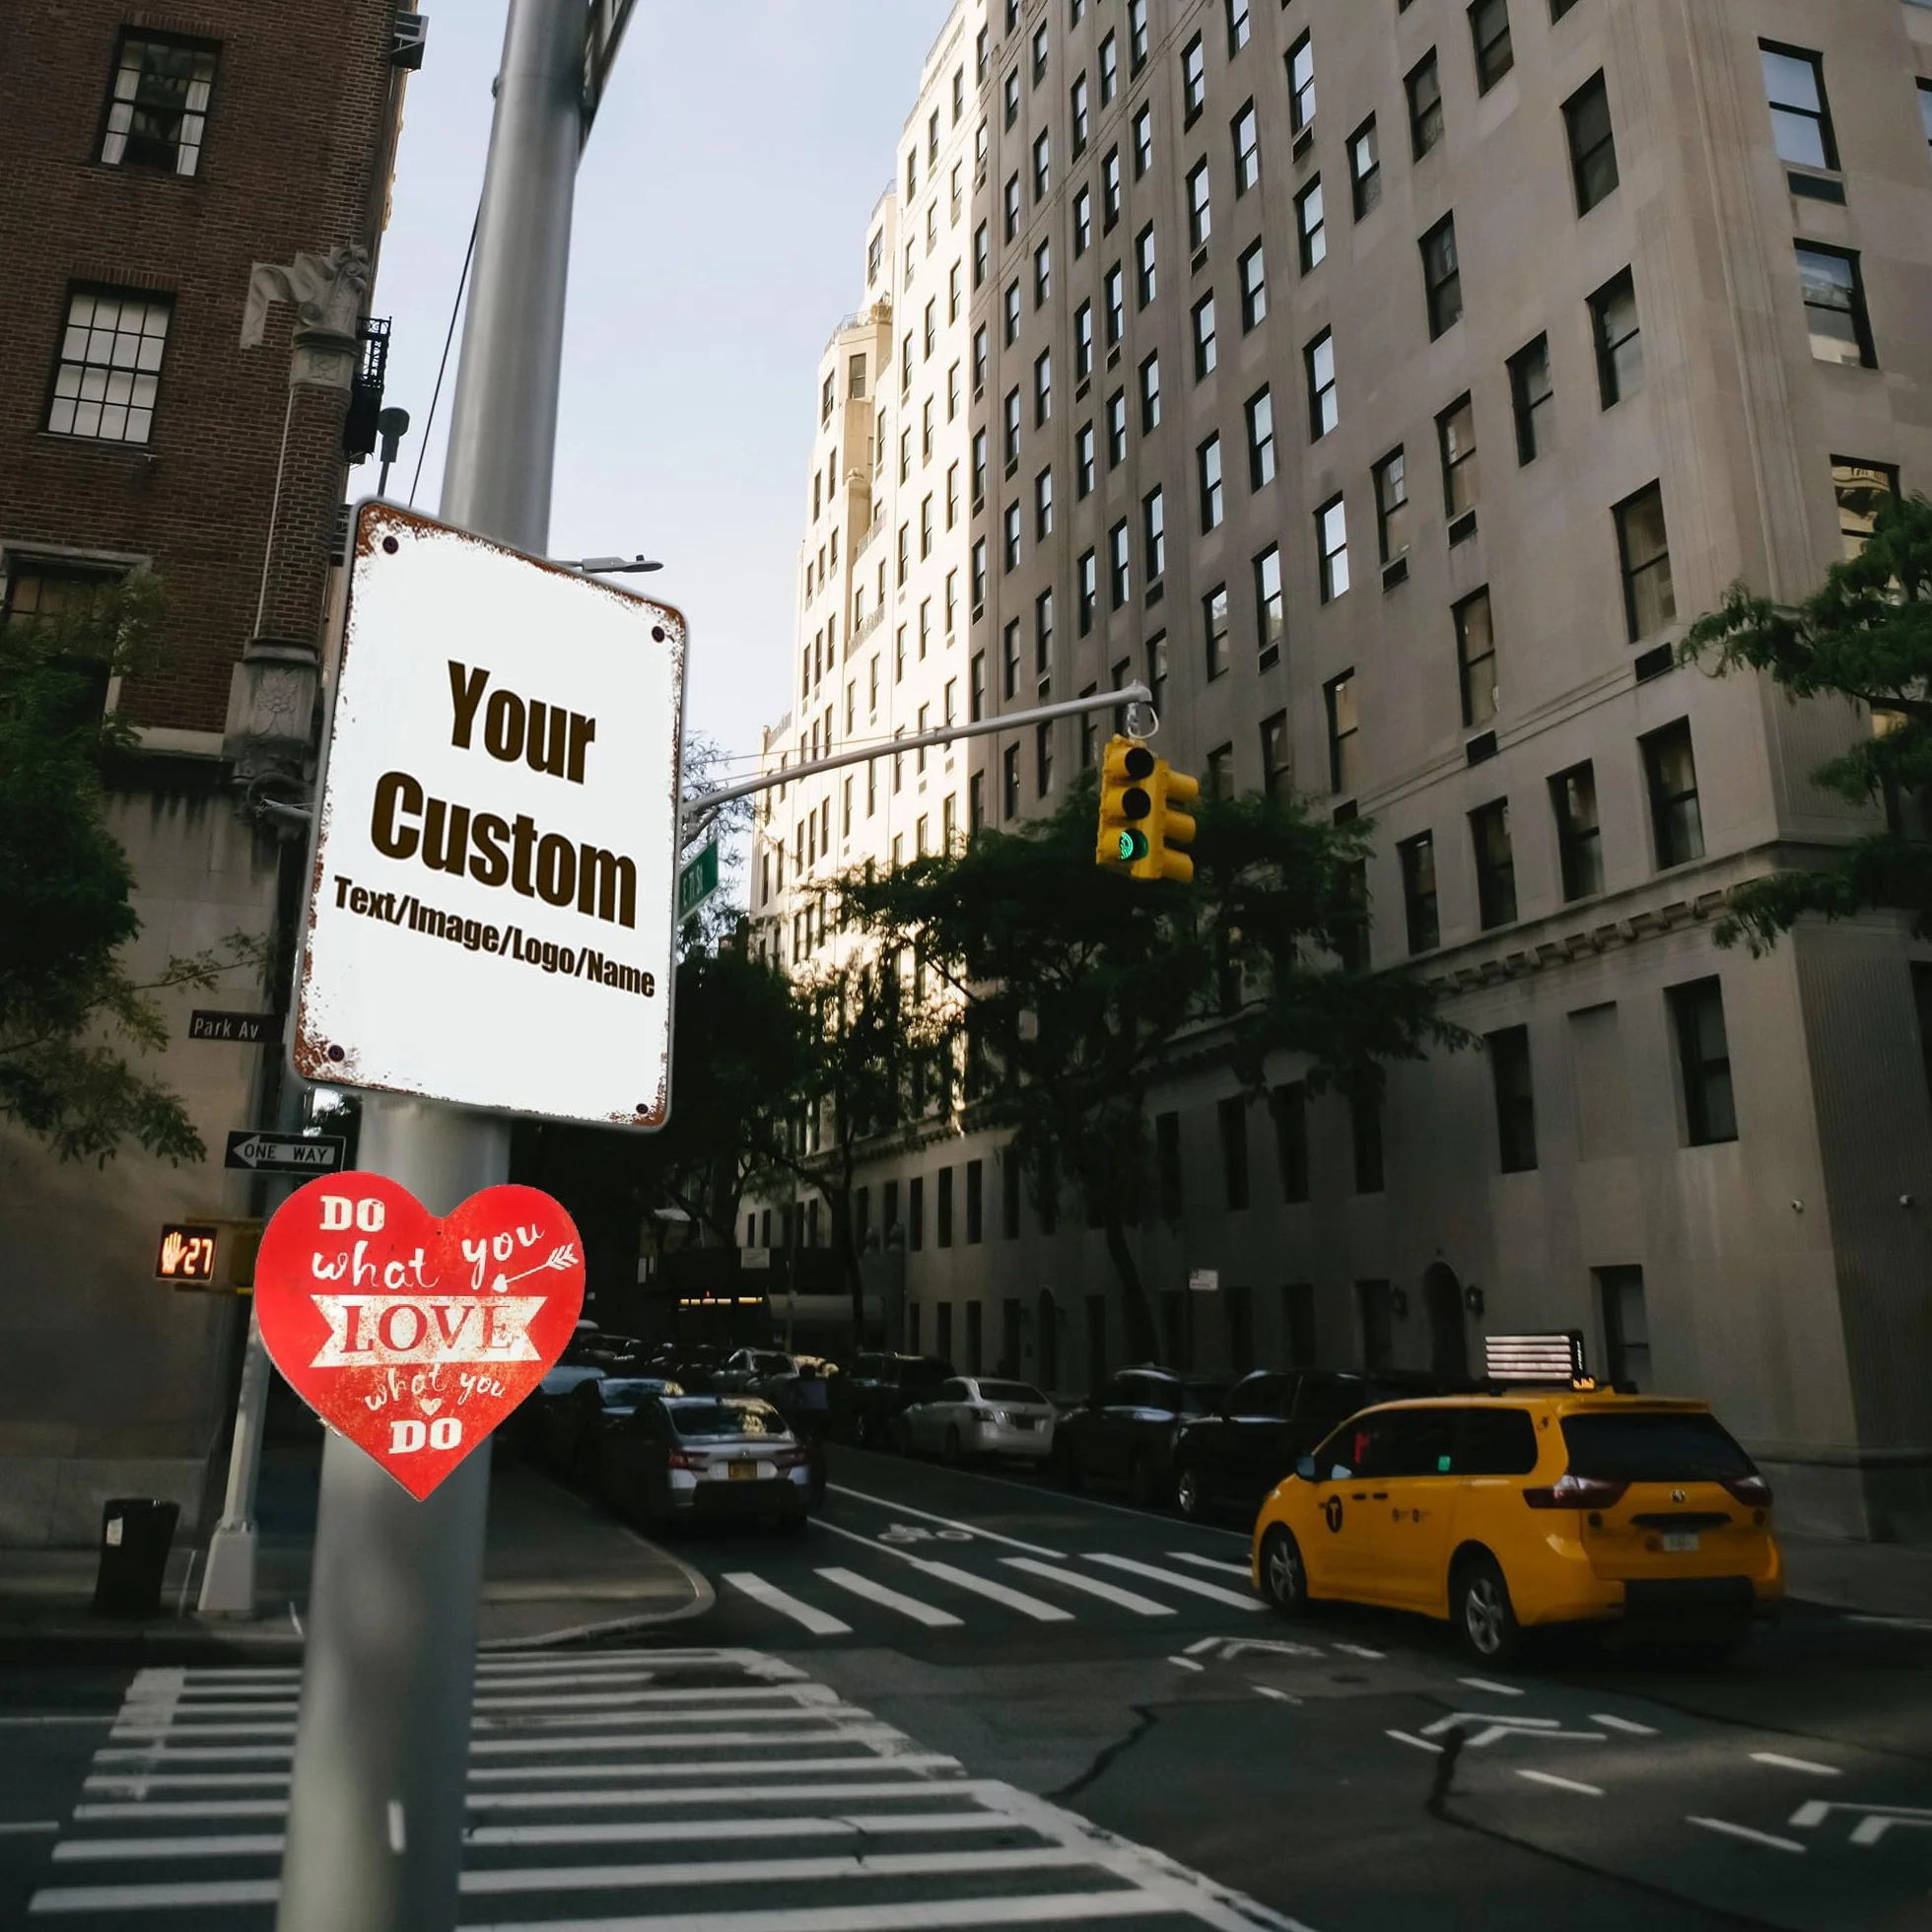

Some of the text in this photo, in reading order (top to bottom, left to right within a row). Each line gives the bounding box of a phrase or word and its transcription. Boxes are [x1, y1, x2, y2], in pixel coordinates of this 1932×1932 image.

[448, 659, 596, 785] Your
[371, 771, 637, 930] Custom
[334, 874, 656, 998] Text/Image/Logo/Name
[193, 1017, 260, 1040] Park Av
[243, 1142, 328, 1163] ONE WAY
[319, 1195, 385, 1232] DO
[183, 1237, 214, 1276] 27
[311, 1223, 546, 1290] what you
[340, 1304, 520, 1354] LOVE
[364, 1366, 506, 1412] what you
[388, 1416, 463, 1455] DO
